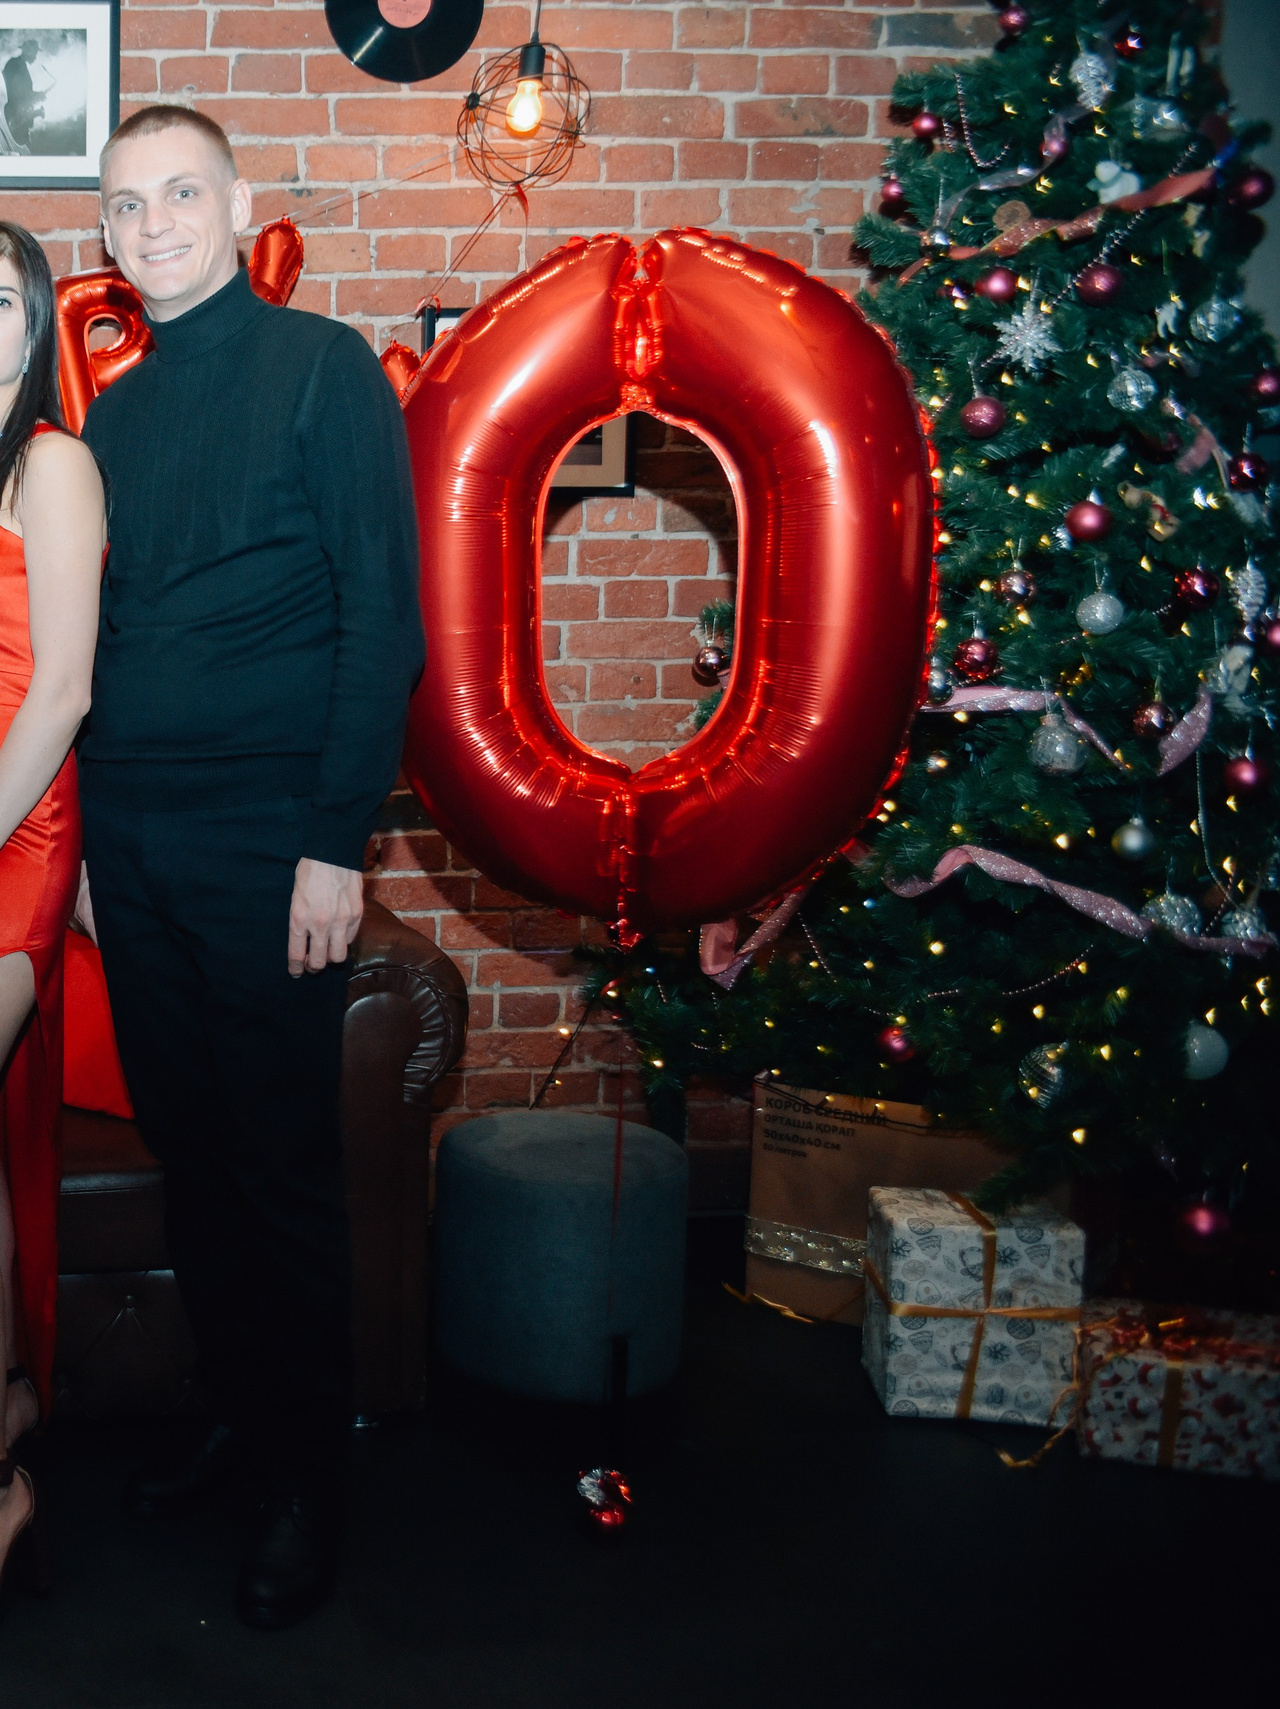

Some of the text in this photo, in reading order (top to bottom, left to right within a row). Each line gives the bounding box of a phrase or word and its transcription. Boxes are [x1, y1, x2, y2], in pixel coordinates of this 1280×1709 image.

[404, 226, 941, 948] 0
[766, 1097, 811, 1115] КОРОБ
[764, 1114, 813, 1130] ОРТАША
[774, 1146, 808, 1158] литров
